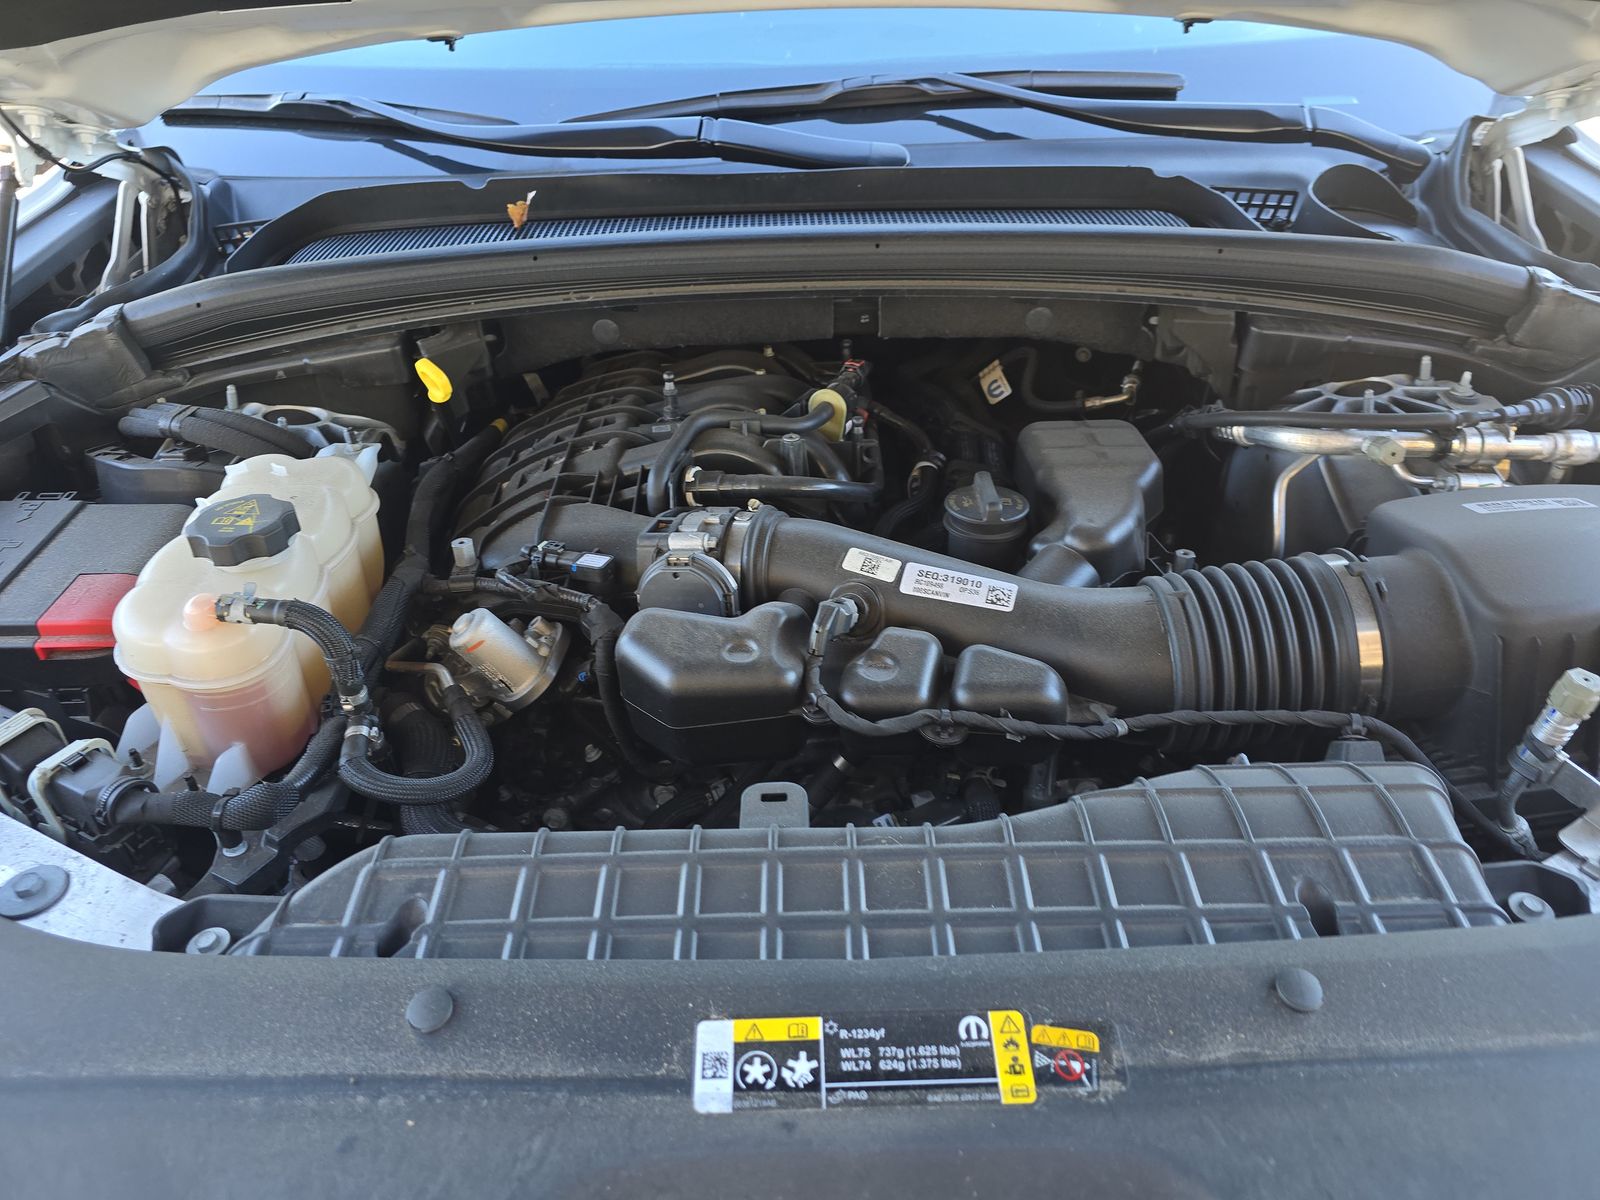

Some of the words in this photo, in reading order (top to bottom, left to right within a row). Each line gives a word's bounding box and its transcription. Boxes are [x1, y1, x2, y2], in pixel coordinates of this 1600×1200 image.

[917, 569, 983, 588] SEQ:319010
[840, 1027, 886, 1041] R-1234yf
[840, 1047, 871, 1059] WL75
[878, 1046, 904, 1059] 737g
[906, 1044, 938, 1058] (1.625
[939, 1044, 960, 1057] lbs)
[841, 1060, 872, 1072] WL74
[879, 1058, 906, 1072] 624g
[907, 1057, 940, 1071] (1.375
[940, 1057, 962, 1070] lbs)
